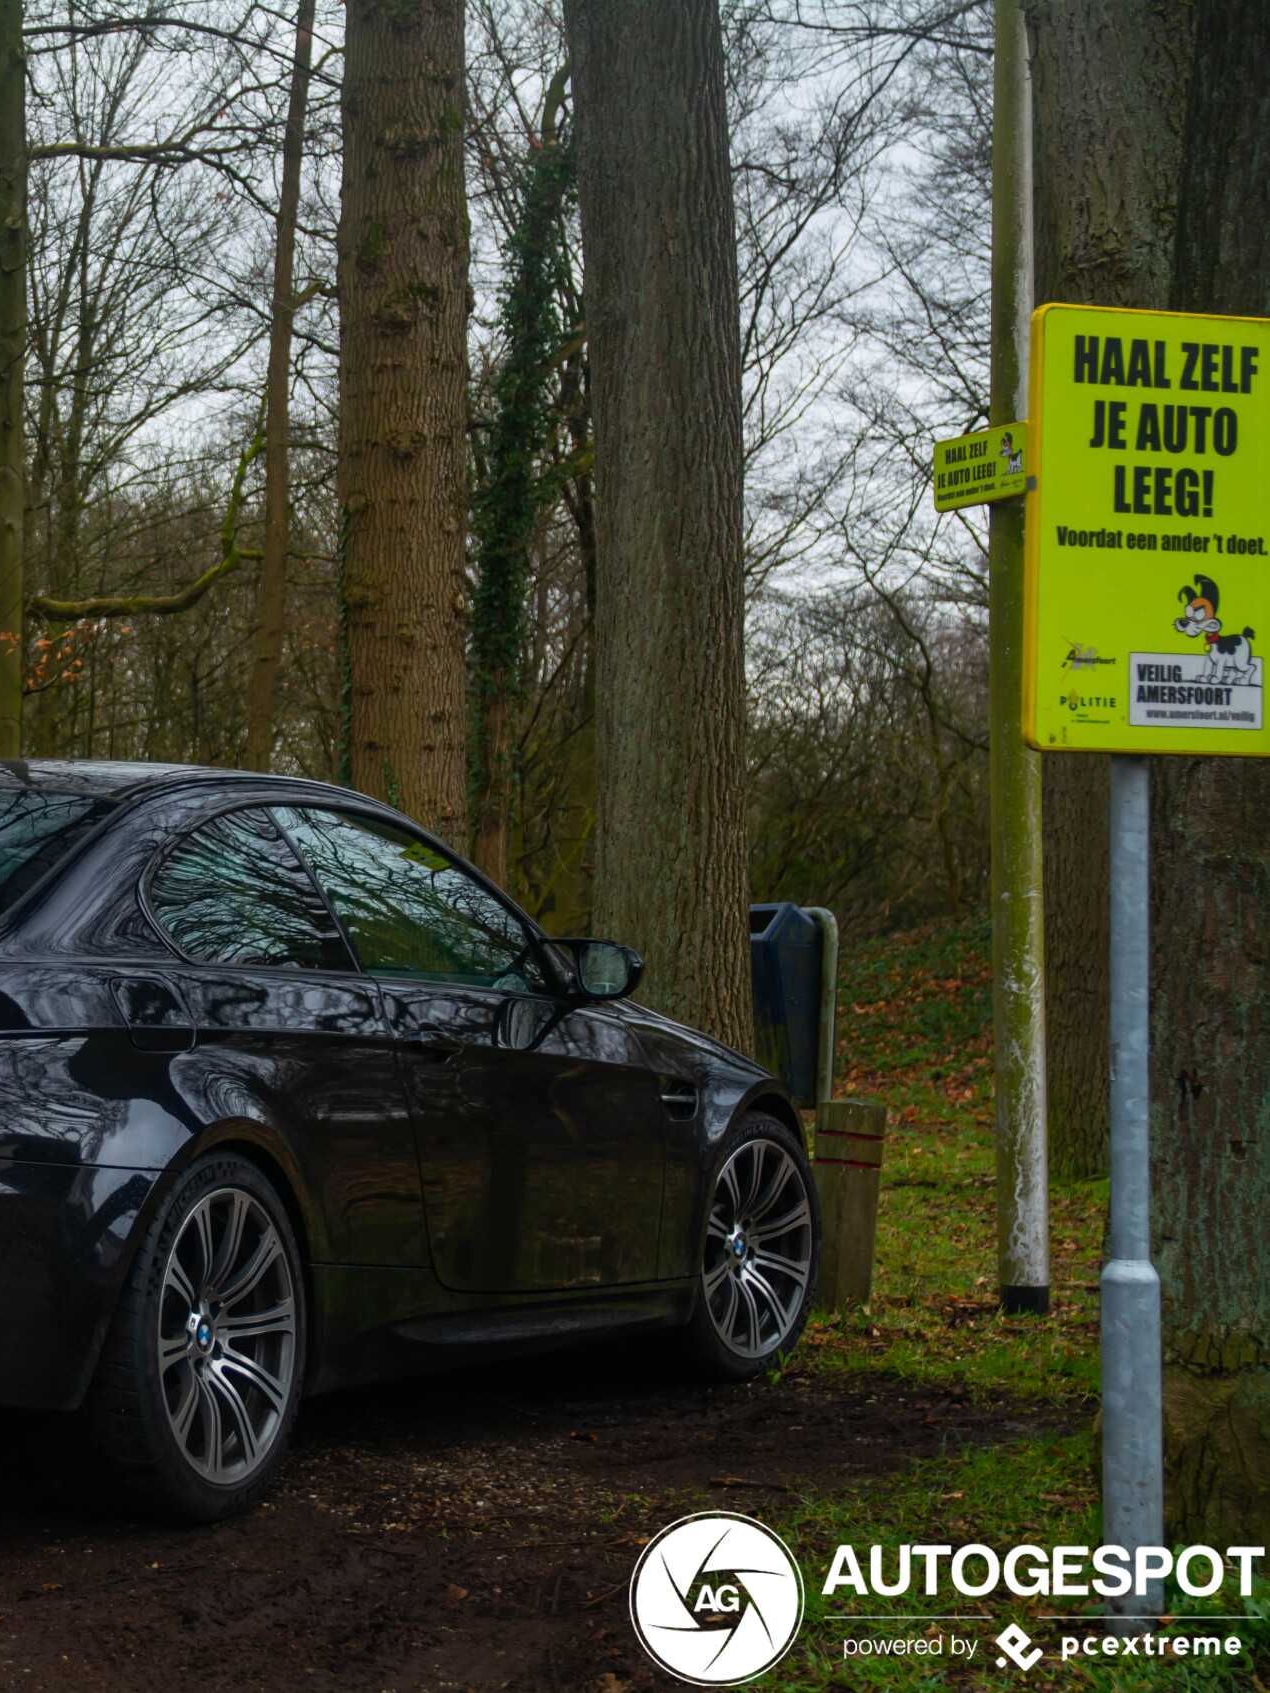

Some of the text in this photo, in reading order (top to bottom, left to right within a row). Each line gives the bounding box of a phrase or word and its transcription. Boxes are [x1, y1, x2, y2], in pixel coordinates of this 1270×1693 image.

[1074, 335, 1259, 394] HAAL ZELF
[1089, 400, 1238, 456] JE AUTO
[945, 440, 988, 465] HAAL ZELF
[937, 461, 996, 489] JE AUTO LEEG!
[1114, 465, 1214, 518] LEEG!
[1056, 525, 1269, 556] Voordat een ander 't doet.
[1136, 663, 1183, 683] VEILIG
[1060, 696, 1116, 711] POLITIE
[1136, 685, 1233, 706] AMERSFOORT
[1146, 708, 1256, 722] www.amersfoort.nl/veilig
